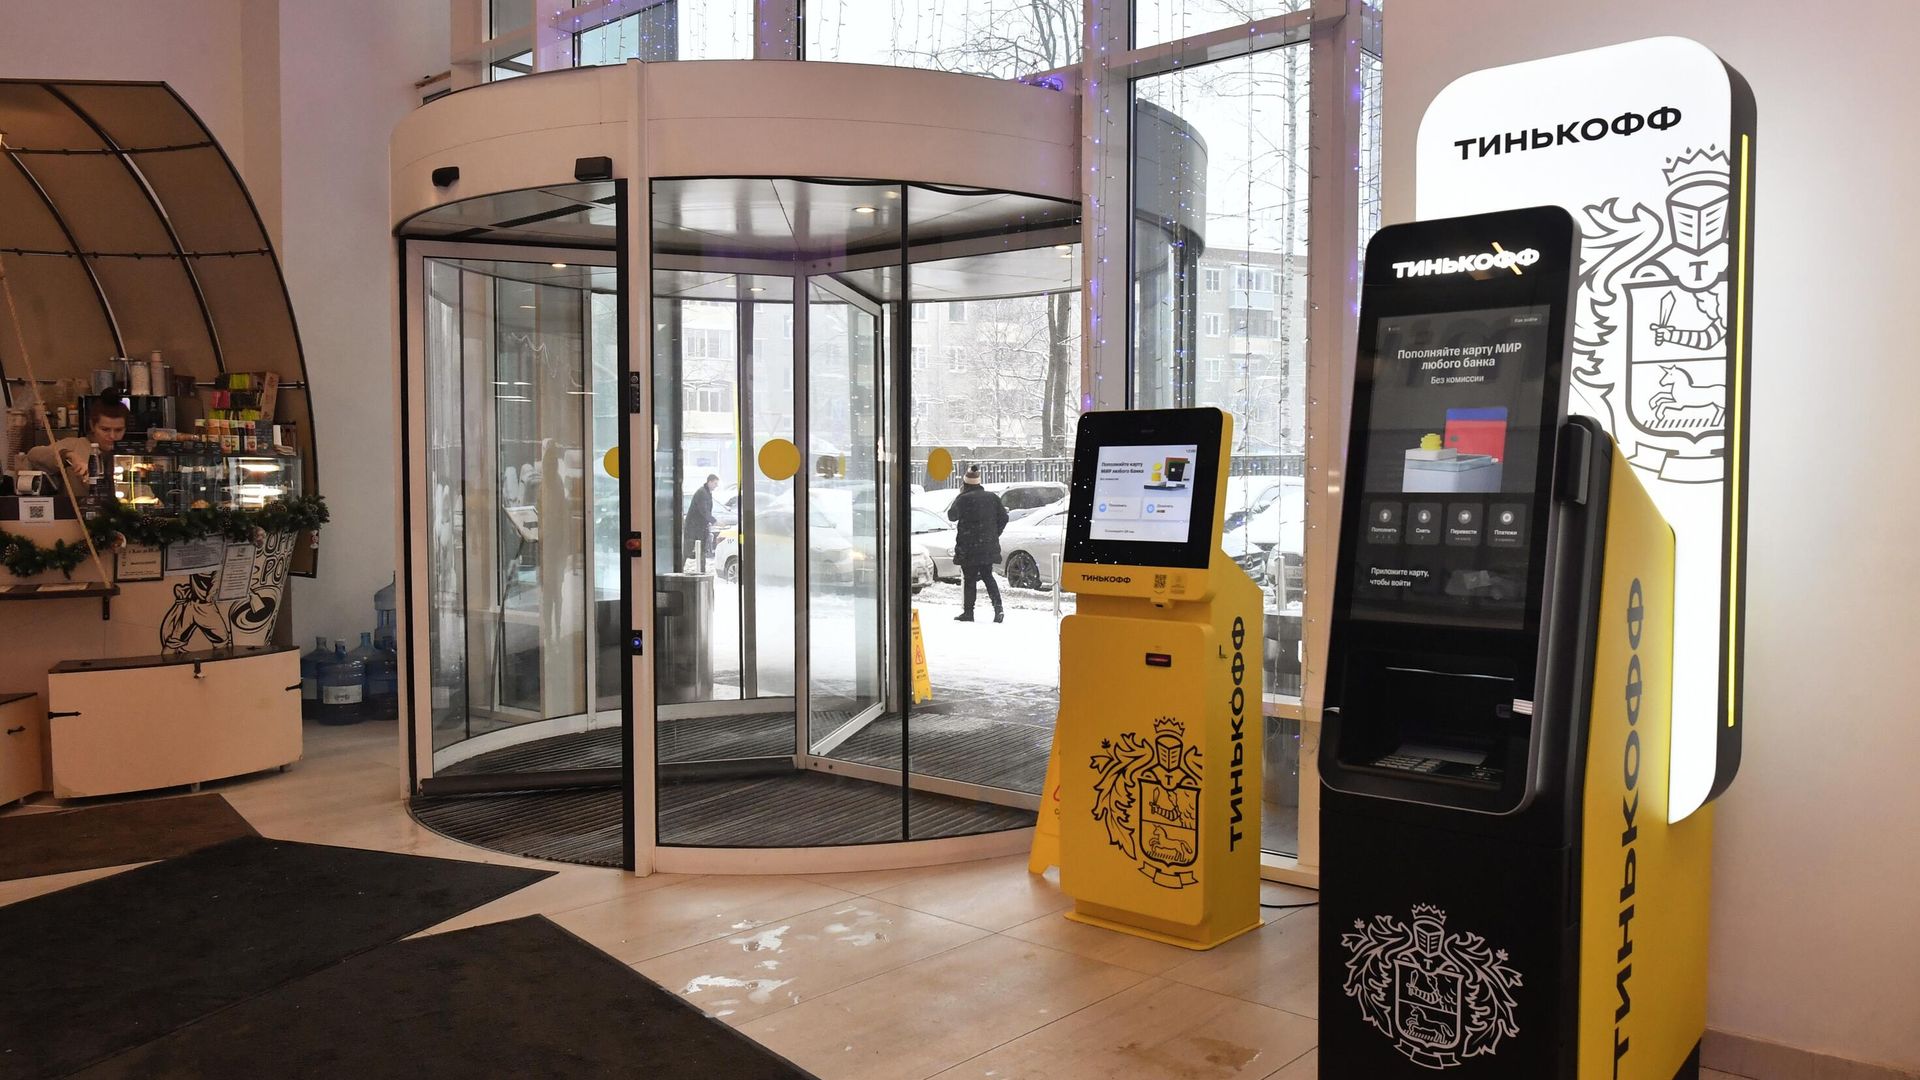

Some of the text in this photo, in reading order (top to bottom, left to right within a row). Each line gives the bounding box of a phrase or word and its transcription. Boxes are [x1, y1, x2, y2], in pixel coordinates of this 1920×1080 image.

[1454, 106, 1682, 160] ТИНЬКОФФ
[1392, 248, 1540, 278] ТИНЬКОФФ
[1397, 342, 1522, 360] Пополняйте карту МИР
[1421, 358, 1496, 370] любого банка
[1430, 375, 1485, 385] Без комиссии
[1081, 574, 1132, 584] ТИНЬКОФФ
[1370, 567, 1430, 578] Приложите карту,
[1369, 578, 1411, 587] чтобы войти
[1230, 616, 1245, 852] ТИНЬКОФФ
[1613, 577, 1645, 1080] ТИНЬКОФФ
